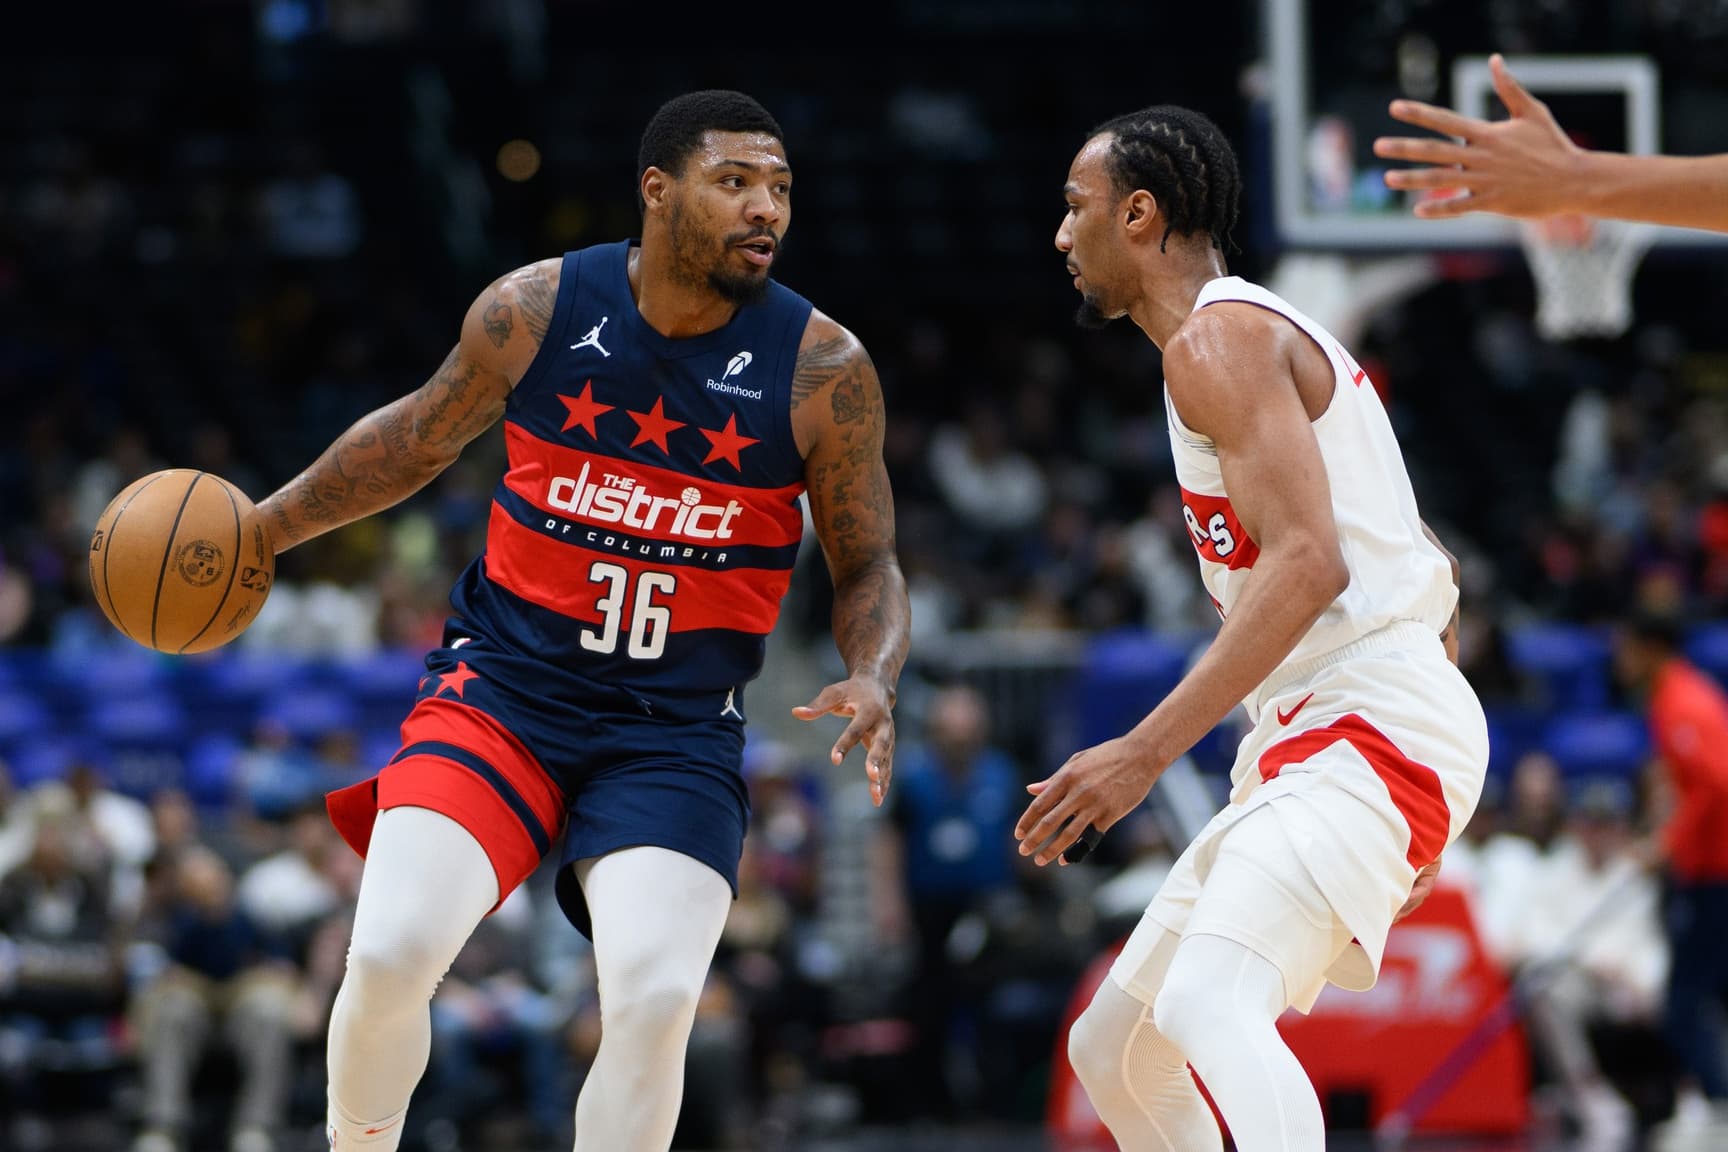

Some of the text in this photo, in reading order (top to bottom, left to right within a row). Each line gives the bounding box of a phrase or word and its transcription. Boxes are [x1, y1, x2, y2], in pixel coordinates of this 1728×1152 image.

[706, 378, 763, 400] Robinhood
[547, 460, 744, 539] district
[602, 473, 636, 491] THE
[545, 519, 728, 563] OF COLUMBIA
[579, 561, 676, 660] 36
